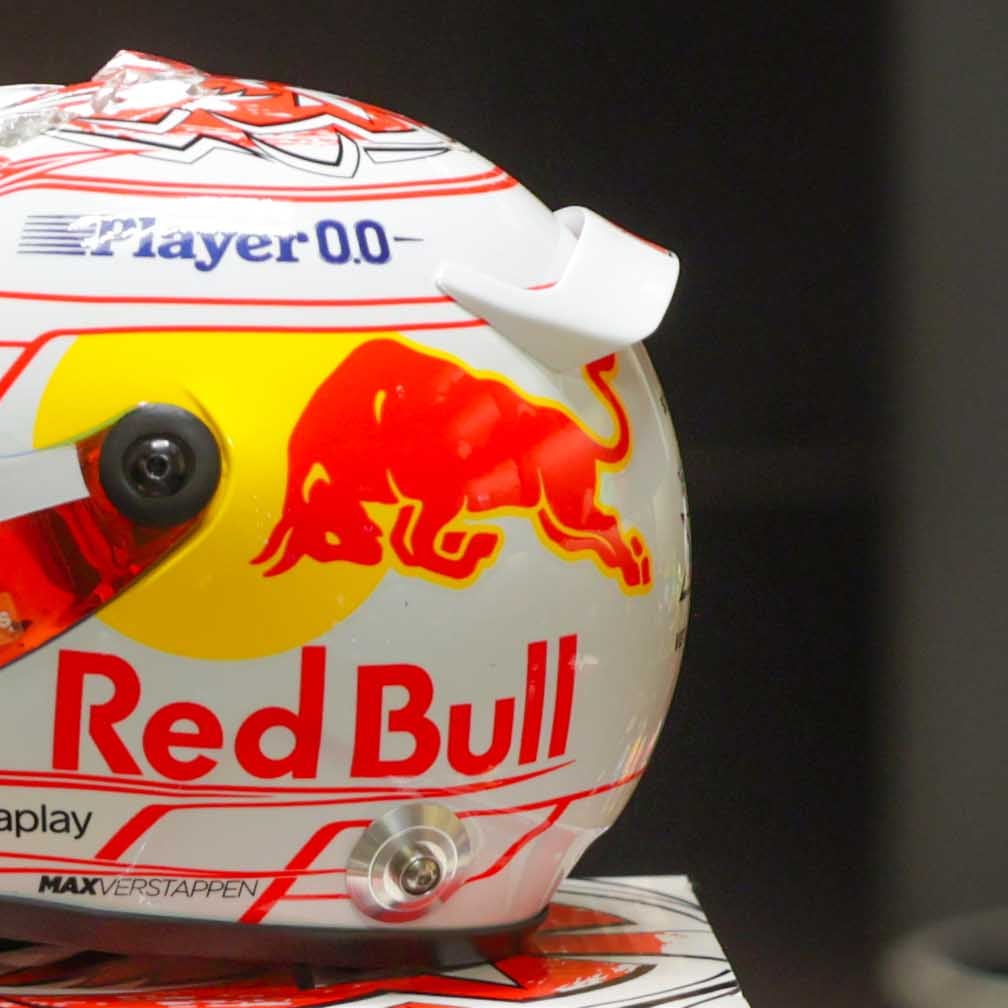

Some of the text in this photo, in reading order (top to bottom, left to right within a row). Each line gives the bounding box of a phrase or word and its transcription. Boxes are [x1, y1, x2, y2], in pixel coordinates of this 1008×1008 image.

[72, 216, 310, 272] Player
[52, 633, 579, 781] Red Bull
